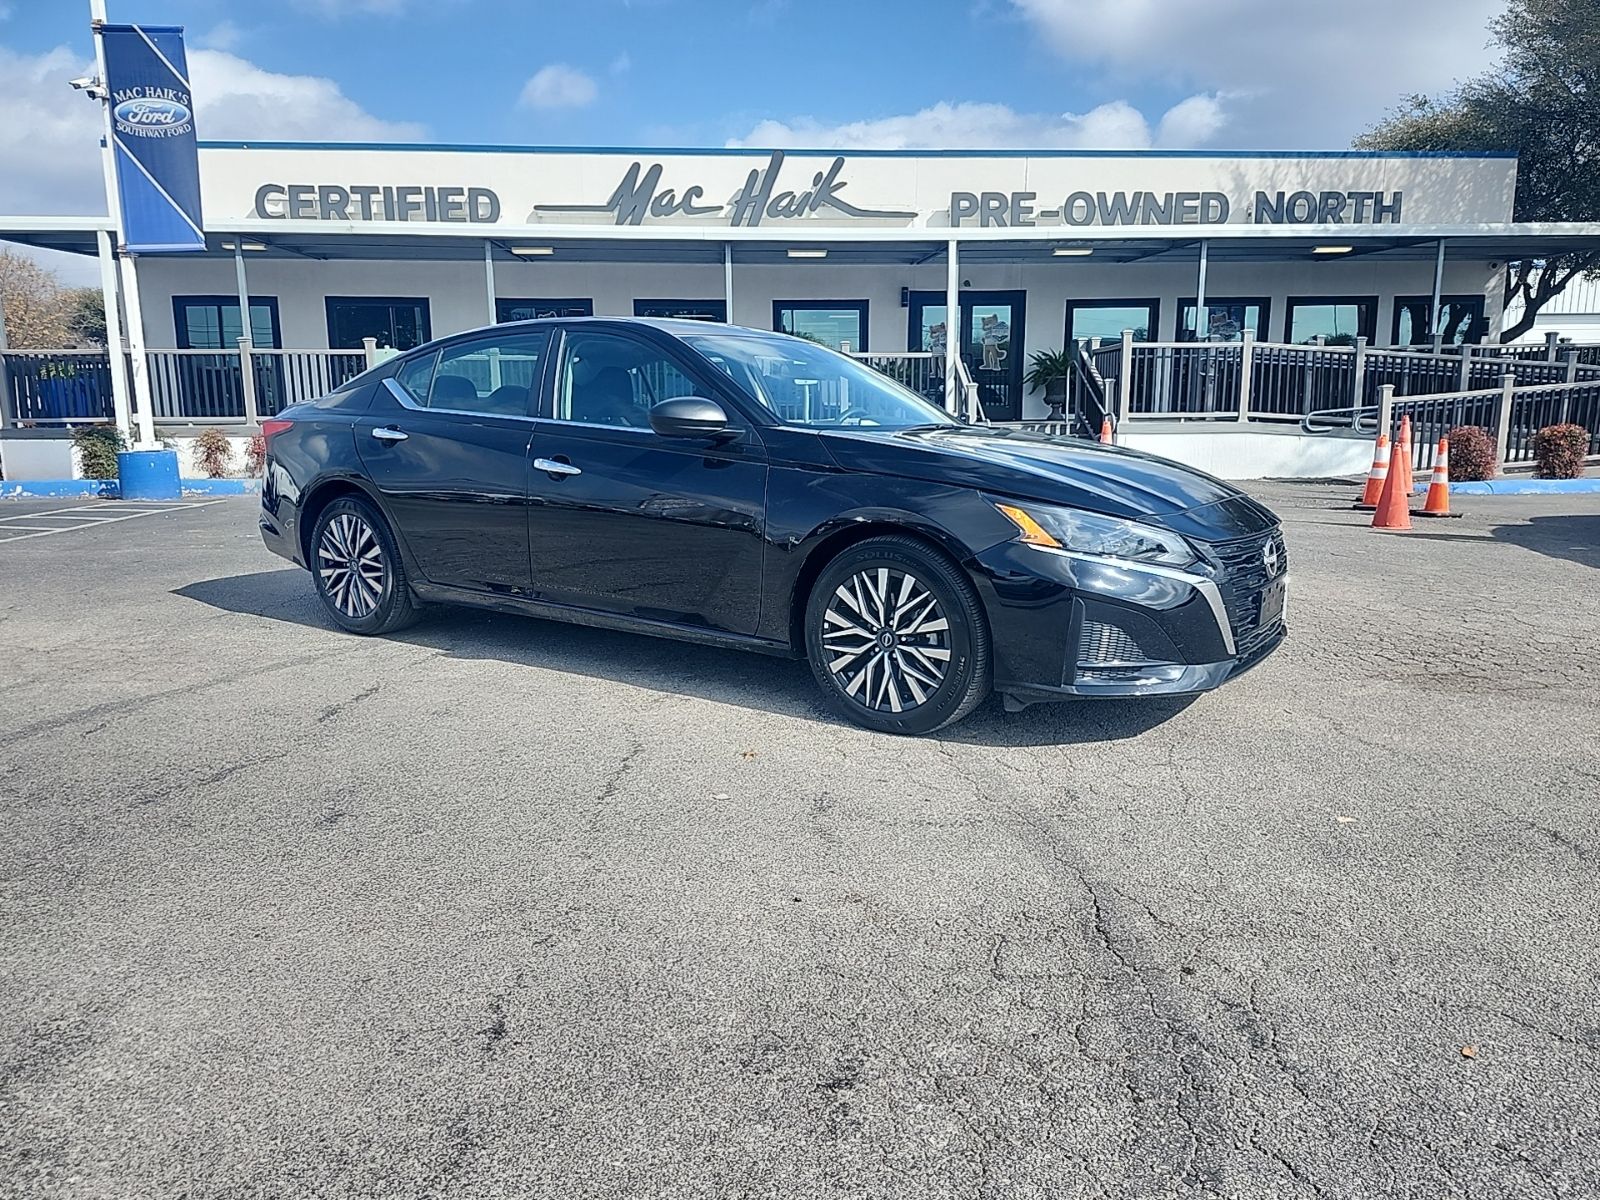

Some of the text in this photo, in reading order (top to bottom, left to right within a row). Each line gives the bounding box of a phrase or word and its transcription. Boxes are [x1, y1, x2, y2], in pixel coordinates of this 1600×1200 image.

[112, 86, 190, 105] MAC HAIK'S
[128, 103, 176, 123] Ford
[116, 122, 192, 139] SOUTHWAY FORD
[534, 150, 918, 227] Mac Haik
[254, 183, 501, 224] CERTIFIED
[950, 190, 1403, 227] PRE-OWNED NORTH
[855, 550, 904, 562] SOLUS
